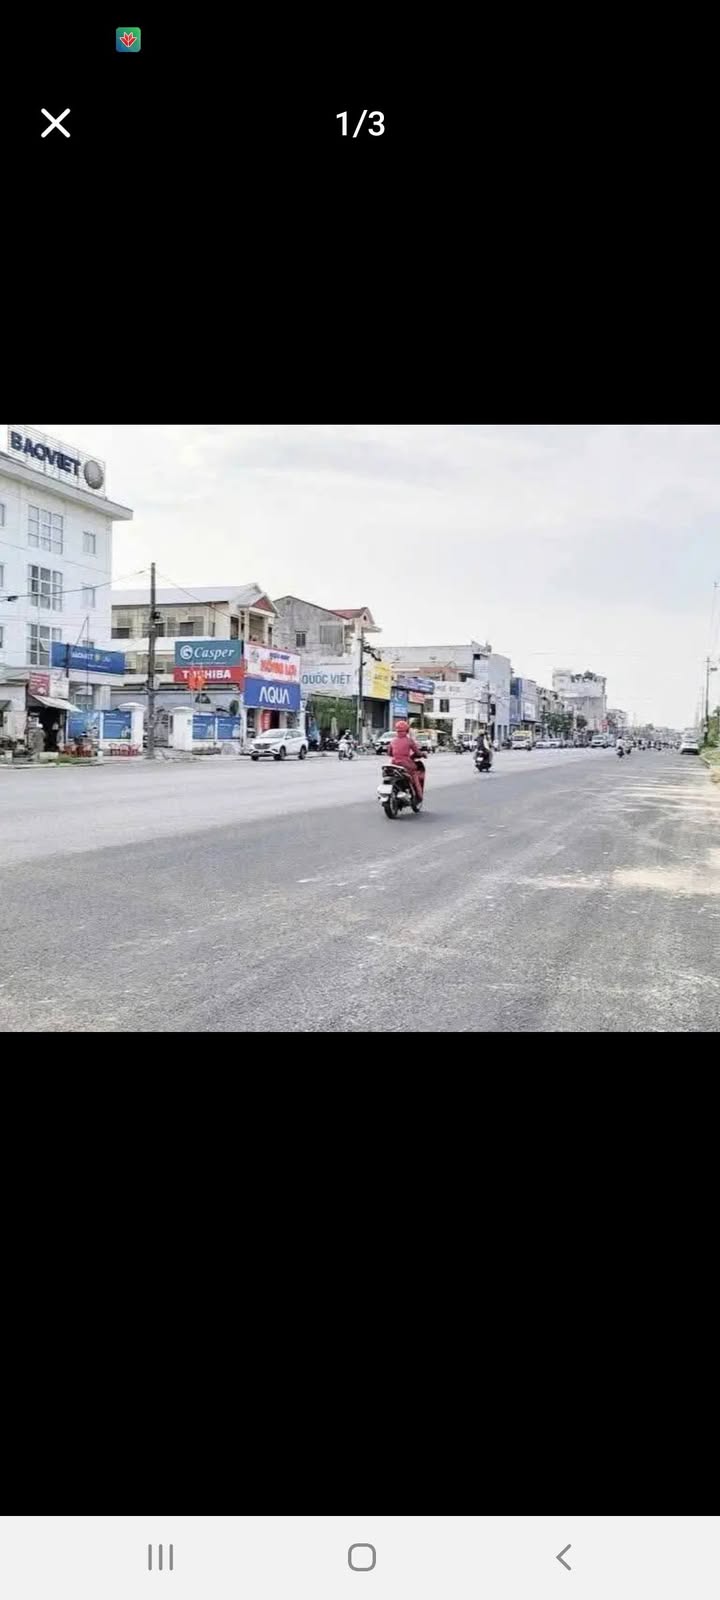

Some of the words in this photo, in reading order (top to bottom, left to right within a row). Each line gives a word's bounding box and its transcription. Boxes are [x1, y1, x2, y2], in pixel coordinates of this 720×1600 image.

[11, 431, 81, 476] BAOVIET
[194, 646, 235, 660] Casper
[182, 669, 232, 679] THIBA
[259, 686, 291, 705] AQUA
